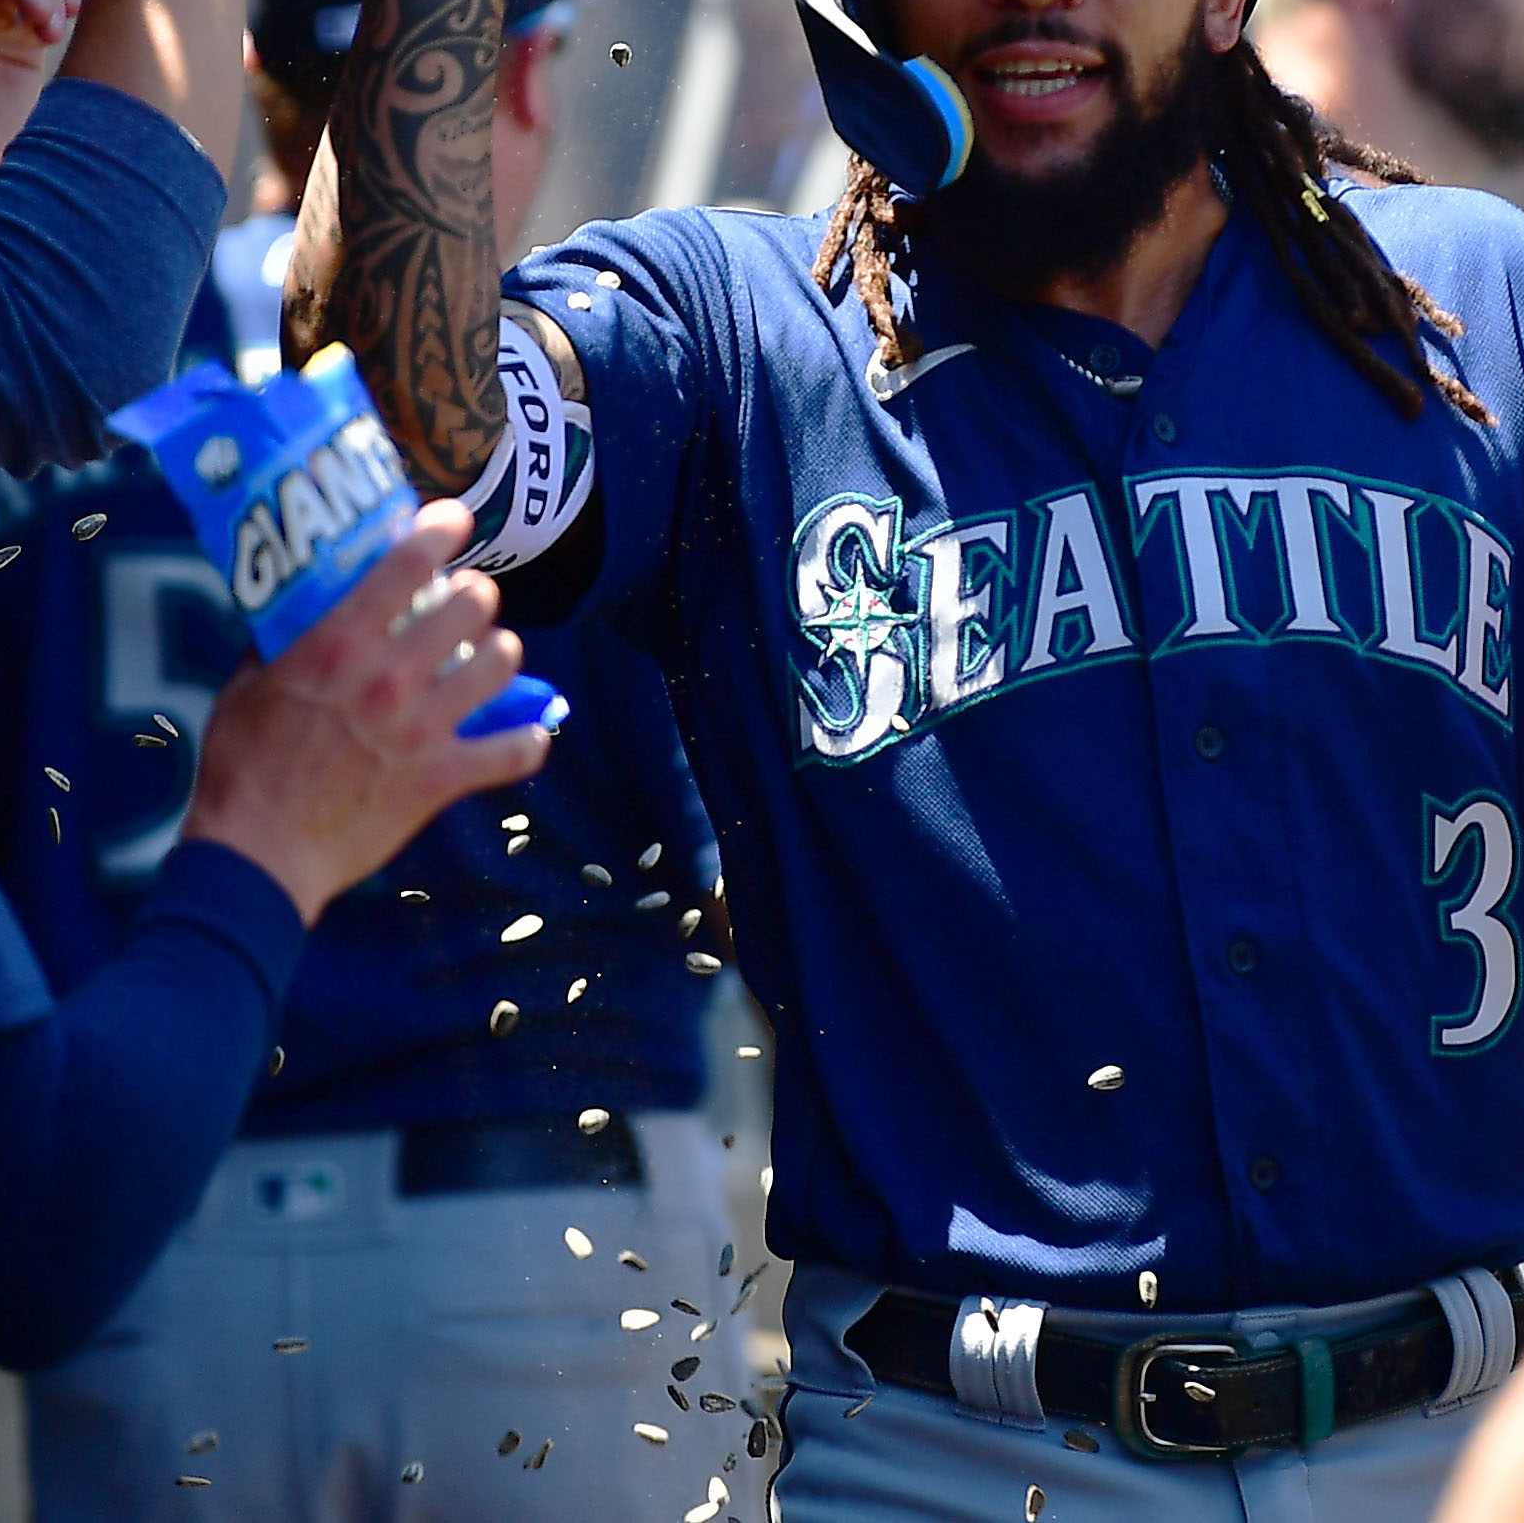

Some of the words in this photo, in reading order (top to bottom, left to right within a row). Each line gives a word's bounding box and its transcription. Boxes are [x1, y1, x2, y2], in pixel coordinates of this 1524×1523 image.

[498, 343, 551, 526] FORD
[789, 468, 1512, 764] SEATTLE
[1424, 788, 1522, 1054] 3
